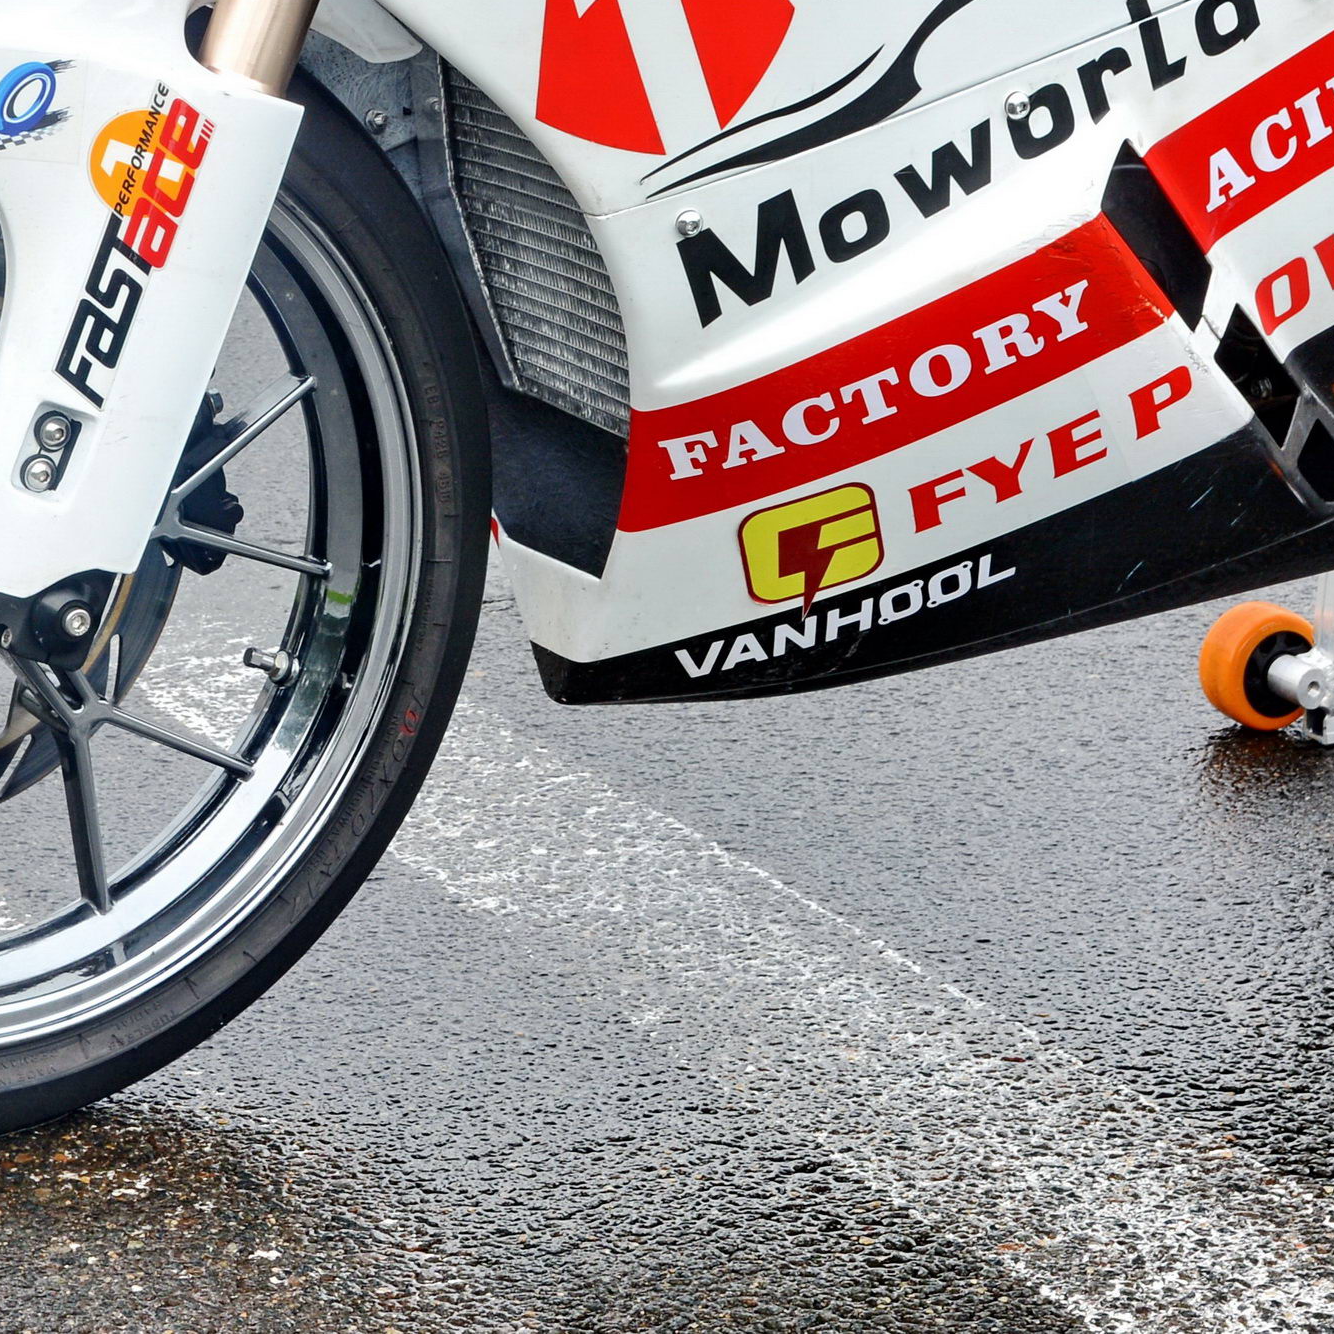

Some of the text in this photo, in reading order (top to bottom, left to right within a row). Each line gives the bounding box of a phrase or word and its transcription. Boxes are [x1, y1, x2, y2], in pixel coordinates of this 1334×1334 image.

[114, 82, 169, 219] PERFORMANCE
[658, 279, 1090, 481] FACTORY
[908, 365, 1193, 532] FYE P
[675, 559, 1017, 678] VANHOOL
